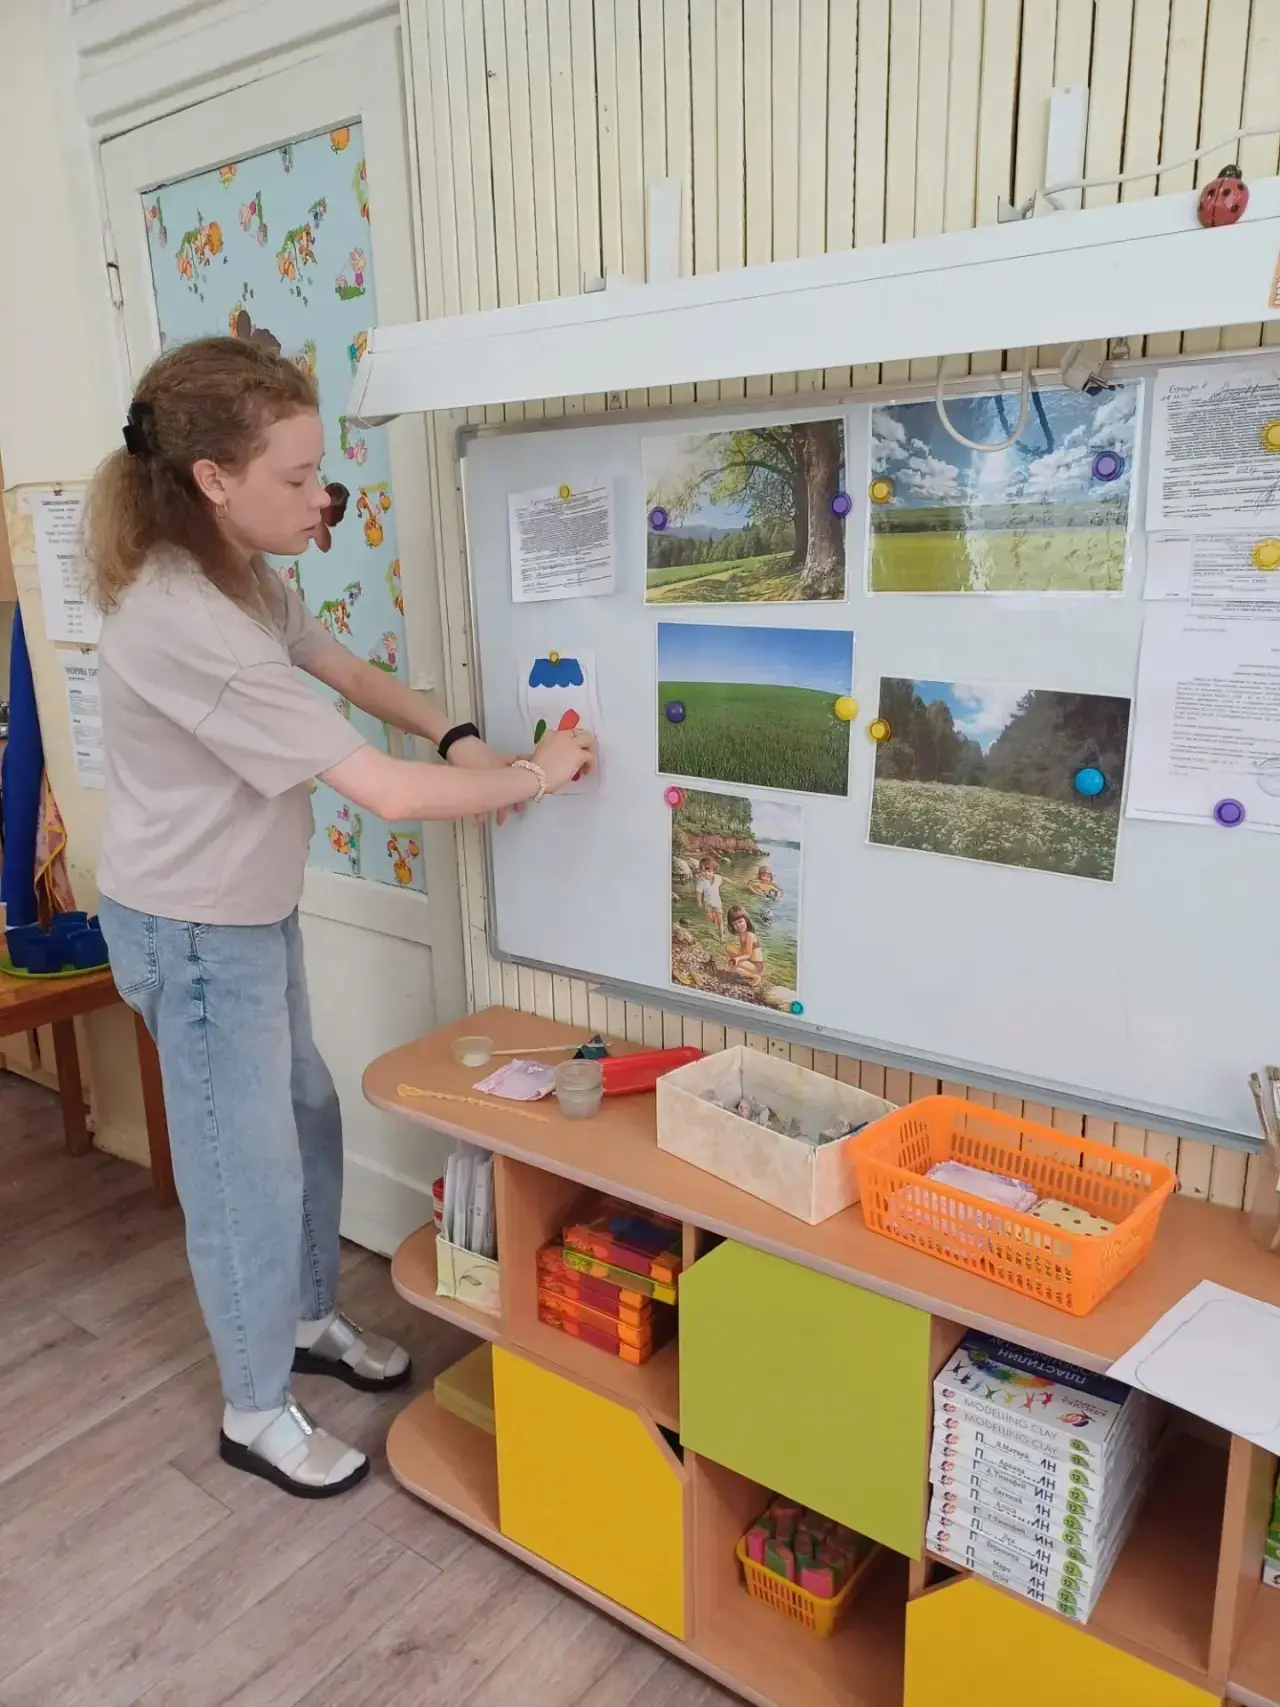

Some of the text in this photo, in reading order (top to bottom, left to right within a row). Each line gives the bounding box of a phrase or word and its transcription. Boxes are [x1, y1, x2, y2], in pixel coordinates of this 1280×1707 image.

[997, 1348, 1088, 1385] ПЛАСТИЛИН
[963, 1397, 1058, 1440] MODELLING CLAY
[963, 1413, 1058, 1454] MODELLING CLAY
